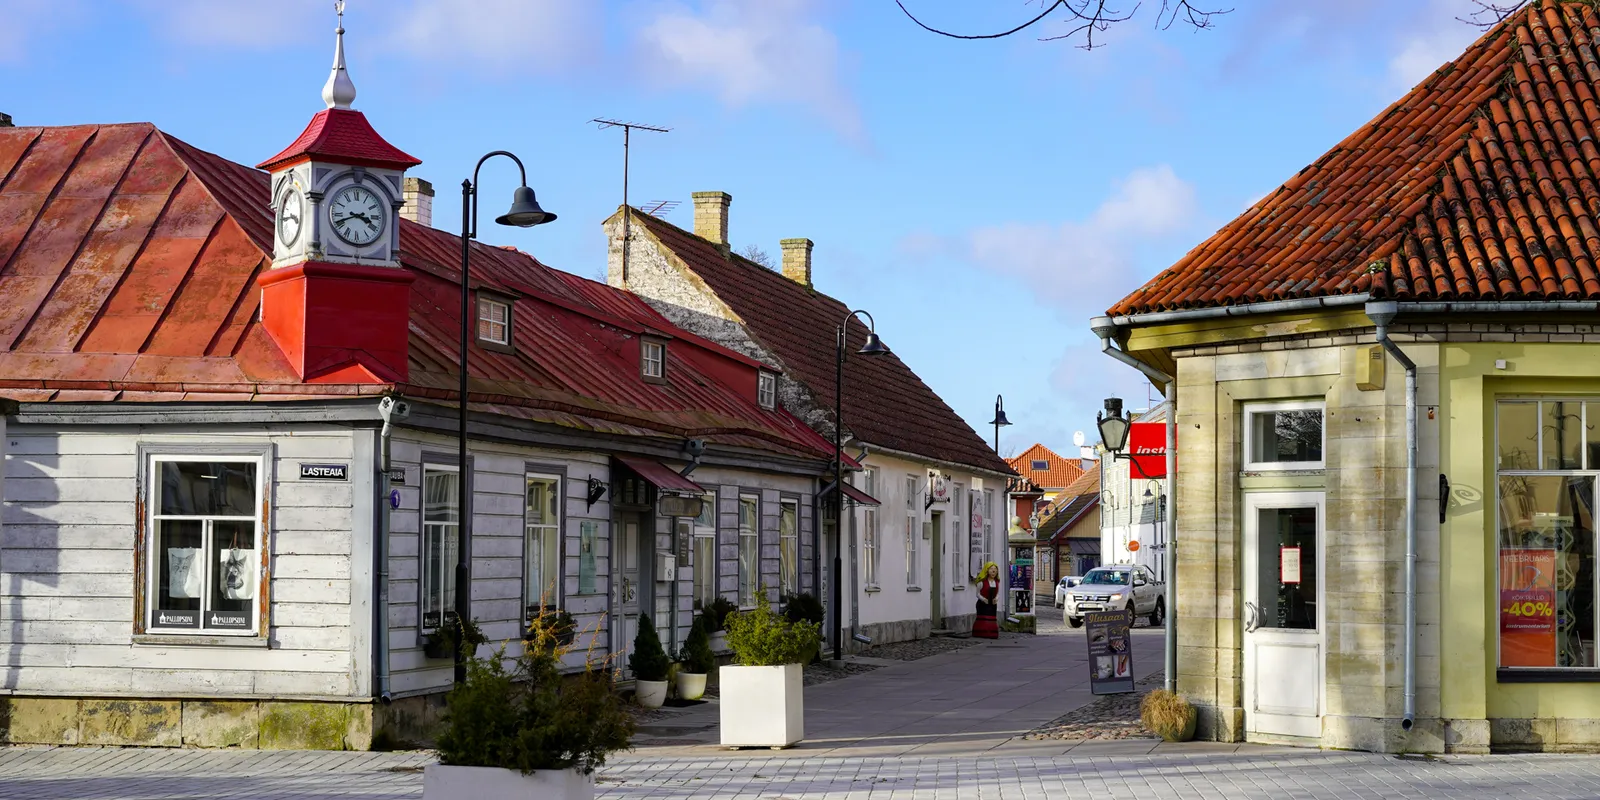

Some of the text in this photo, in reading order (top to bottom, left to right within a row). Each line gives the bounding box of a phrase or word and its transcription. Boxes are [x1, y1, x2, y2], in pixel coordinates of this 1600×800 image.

[1136, 445, 1167, 457] inst
[302, 467, 343, 477] LASTEAIA
[1503, 554, 1550, 563] VEEBRUARIS
[1503, 602, 1553, 616] -40%
